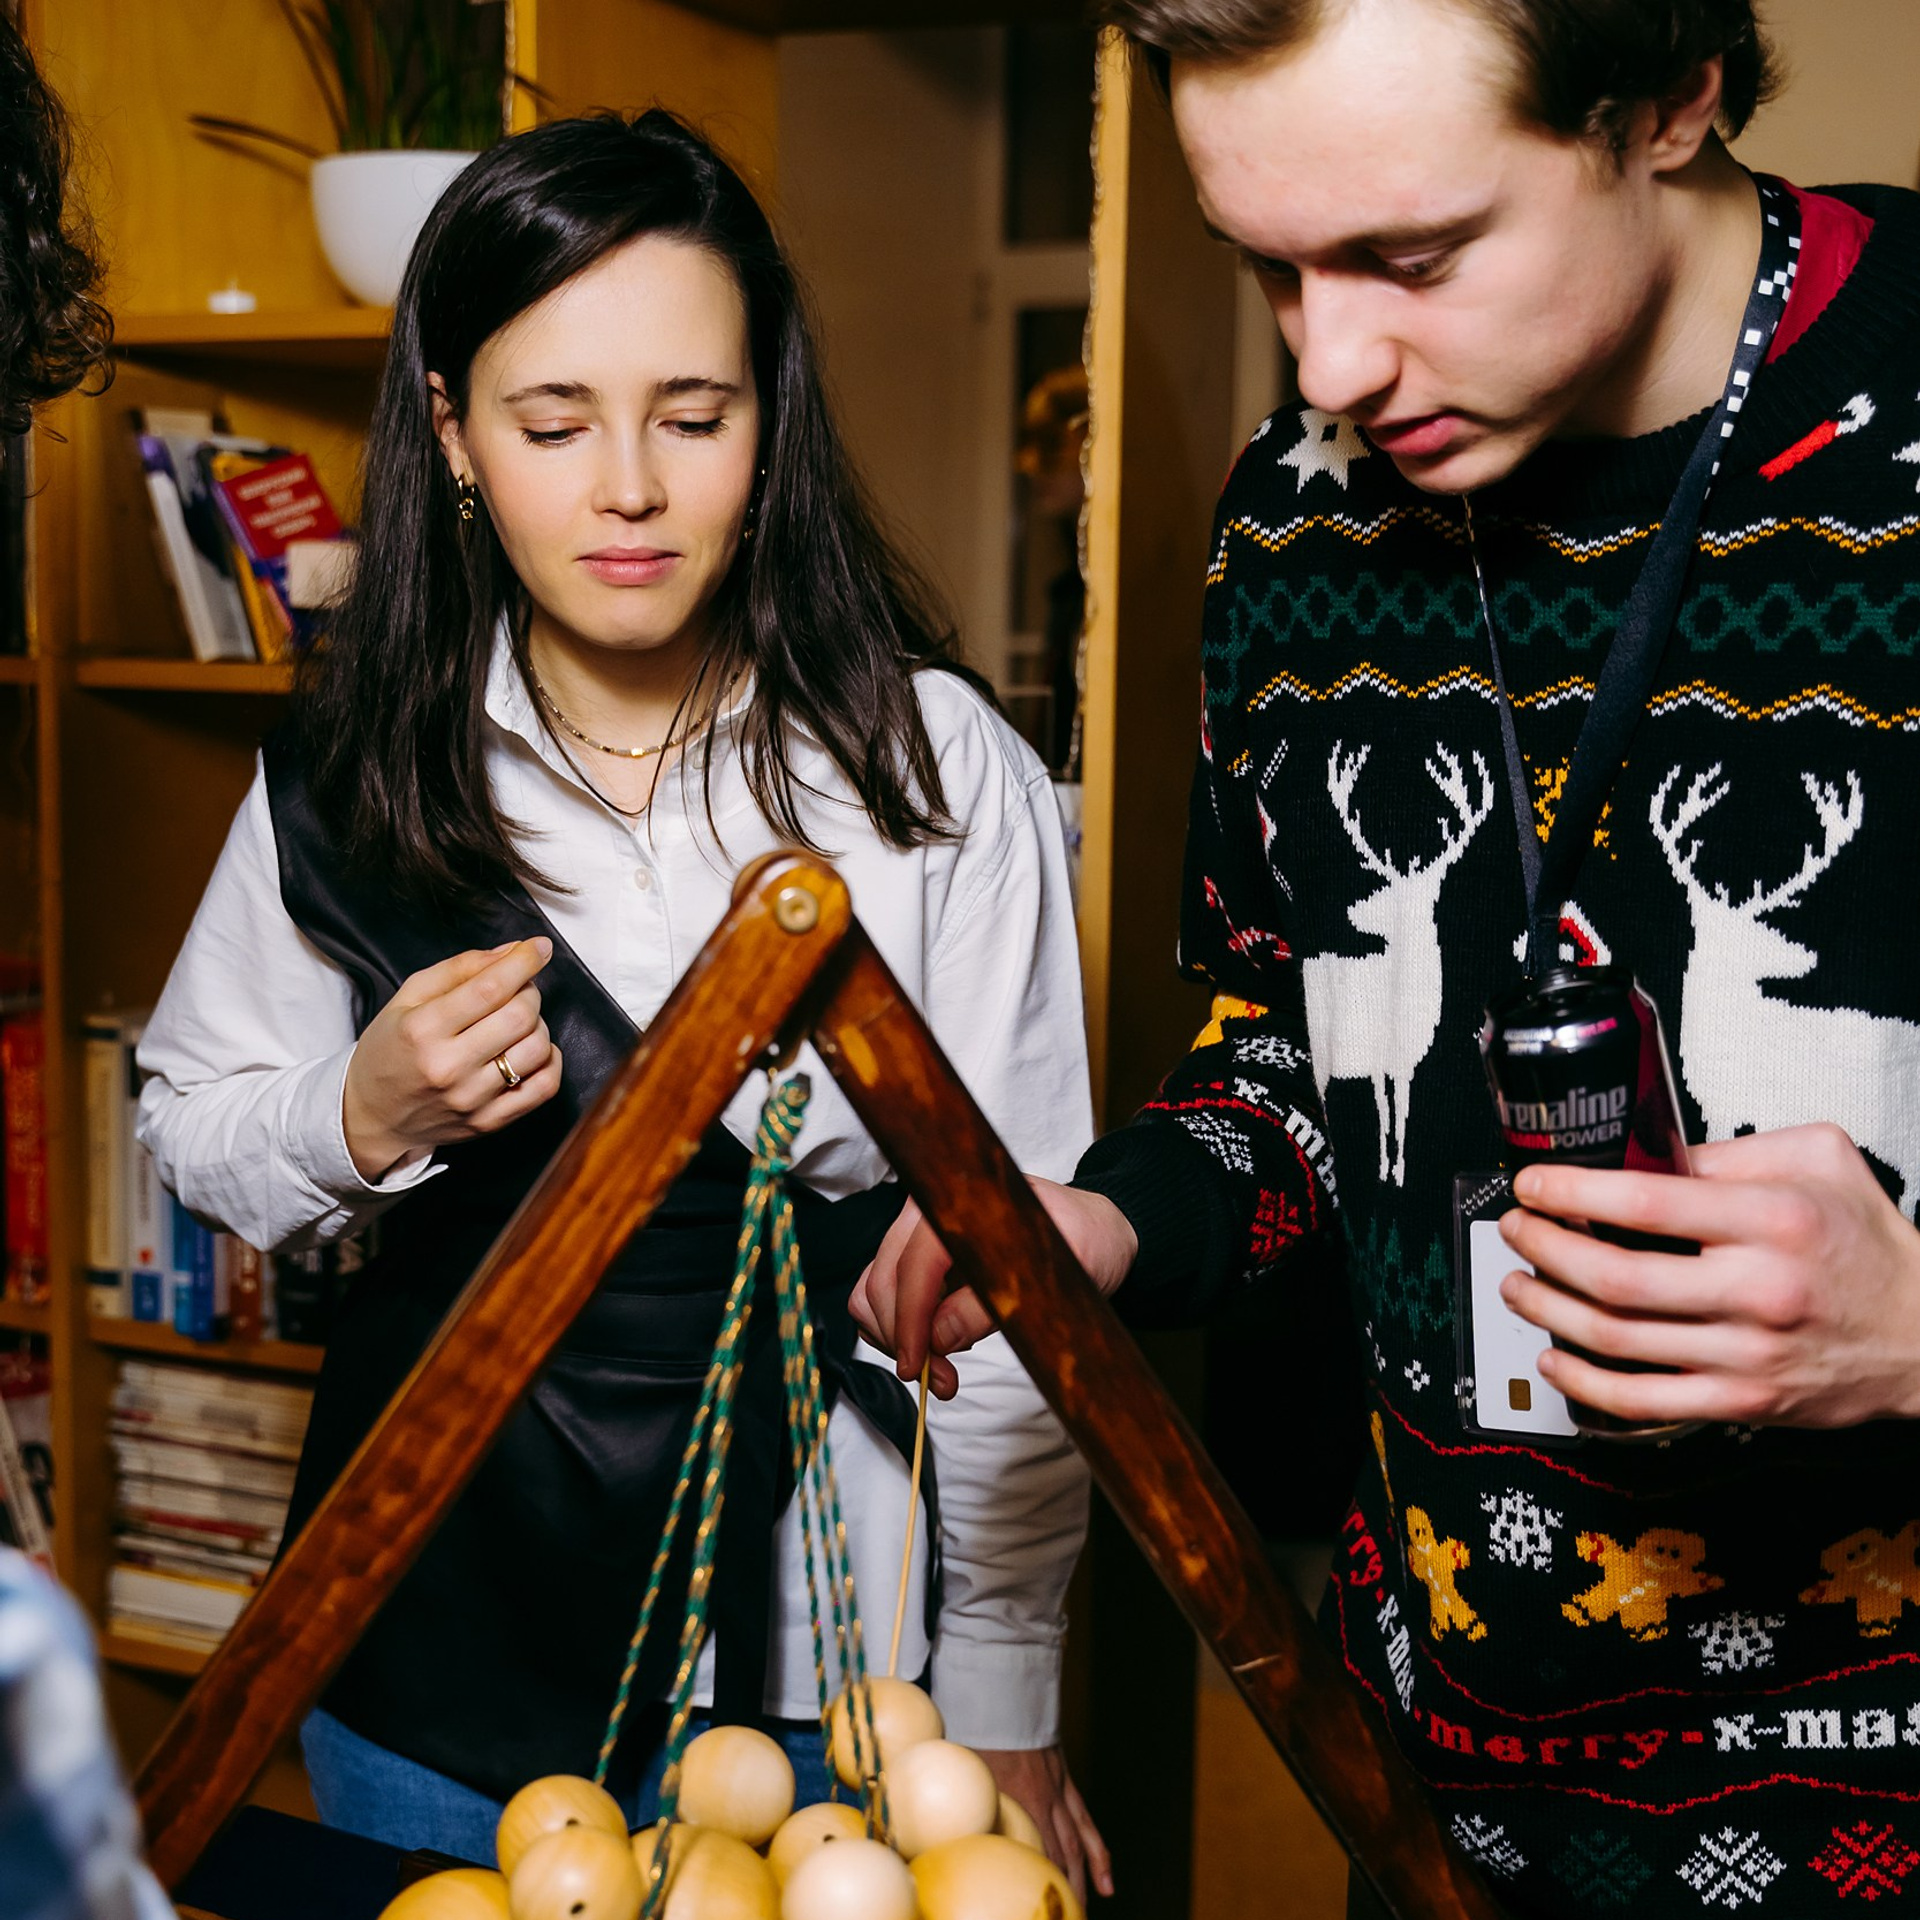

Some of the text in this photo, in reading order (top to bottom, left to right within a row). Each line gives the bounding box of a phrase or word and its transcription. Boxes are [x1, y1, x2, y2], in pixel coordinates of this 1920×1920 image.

[1497, 1085, 1627, 1131] renaline
[1550, 1120, 1622, 1150] POWER
[1232, 1076, 1340, 1209] x-ma
[1426, 1708, 1669, 1770] merry
